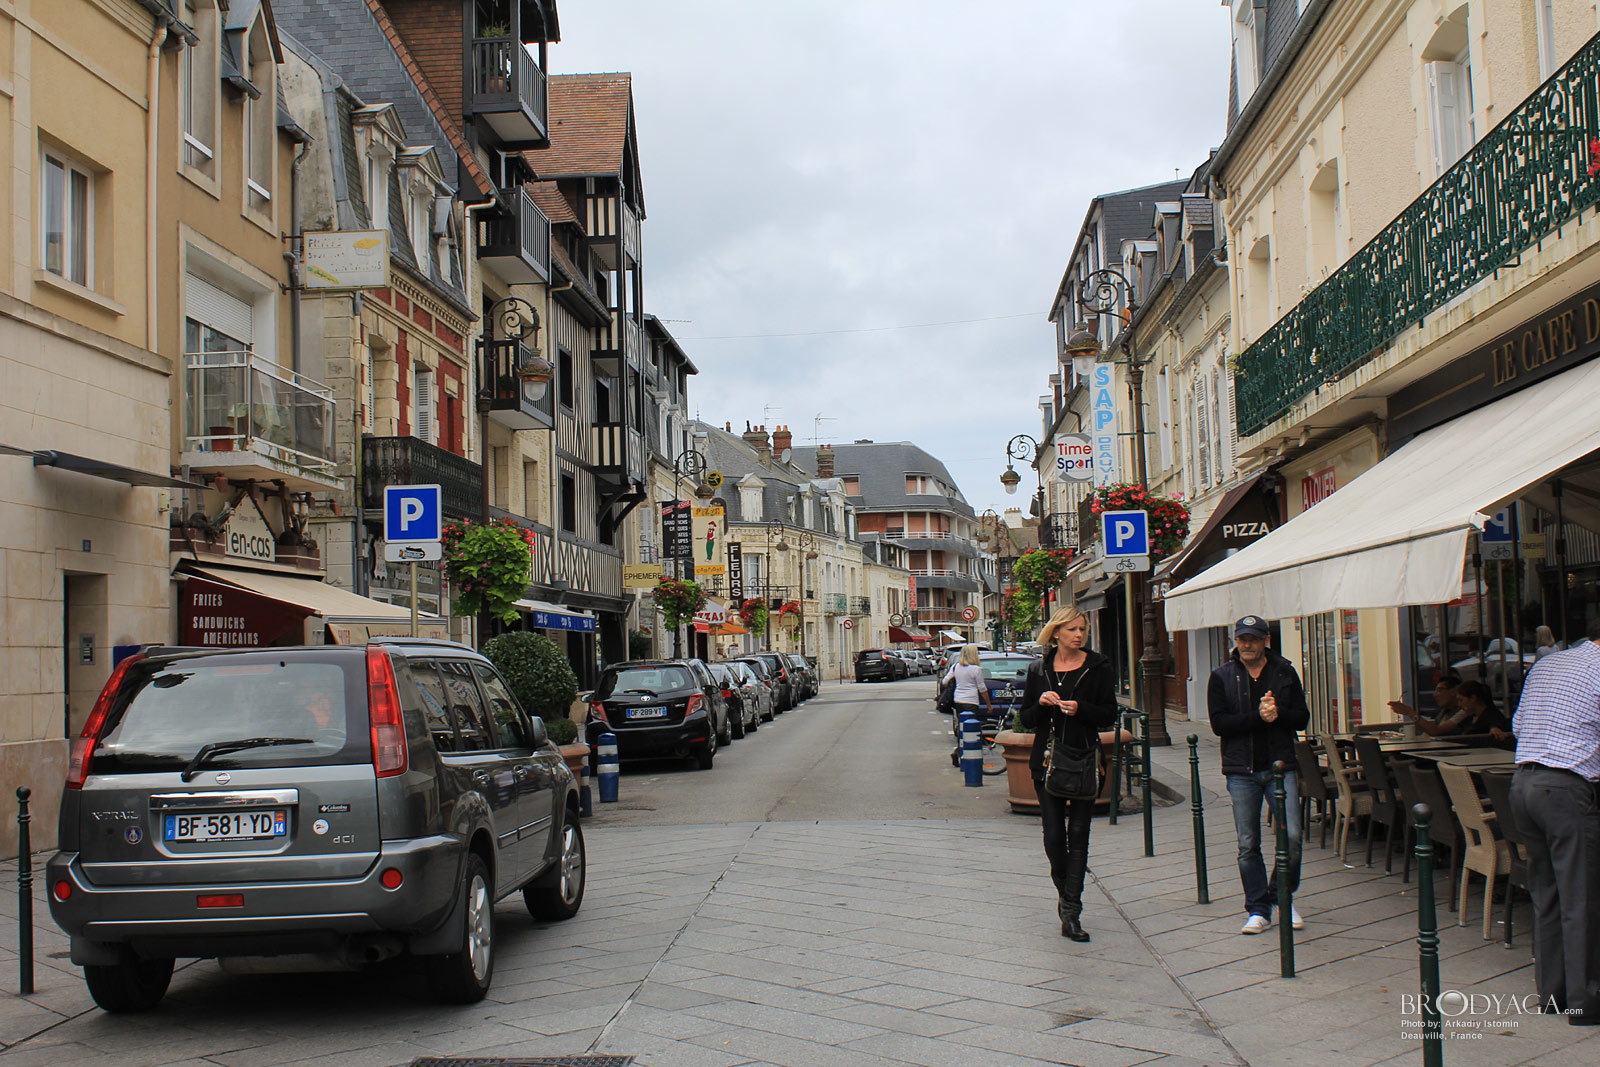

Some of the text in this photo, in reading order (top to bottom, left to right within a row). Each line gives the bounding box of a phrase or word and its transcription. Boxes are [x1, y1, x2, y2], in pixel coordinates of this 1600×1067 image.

[1491, 340, 1517, 387] LE
[1522, 309, 1577, 372] CAFE
[1095, 366, 1113, 431] SAP
[1057, 443, 1092, 455] Time
[401, 497, 424, 531] P
[225, 523, 271, 558] l'en-cas
[1115, 521, 1135, 547] P
[1223, 522, 1270, 538] PIZZA
[624, 572, 662, 580] EPHEMERE
[730, 545, 741, 597] FLEURS
[193, 593, 223, 607] FRITES
[193, 616, 245, 629] SANDWICHS
[203, 632, 259, 645] AMERICAINS
[178, 814, 272, 837] BF-581-YD
[275, 823, 284, 833] 14
